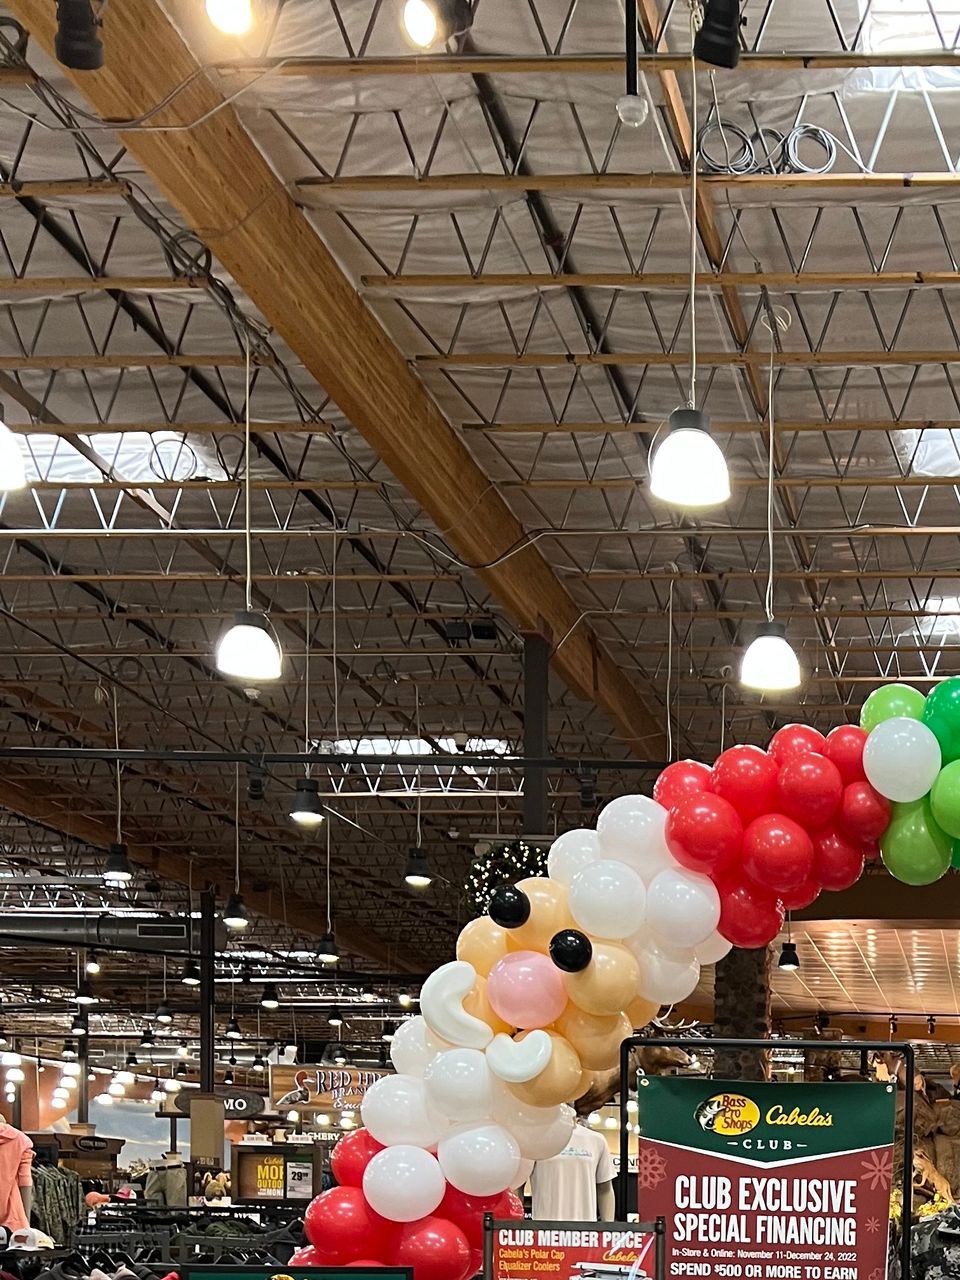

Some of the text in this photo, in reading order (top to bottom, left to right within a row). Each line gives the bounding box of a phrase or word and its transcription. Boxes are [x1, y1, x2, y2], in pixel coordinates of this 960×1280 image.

[722, 1095, 747, 1108] Bass
[722, 1107, 741, 1118] Pro
[765, 1105, 834, 1127] Cabela's
[721, 1117, 753, 1131] Shops
[742, 1139, 793, 1150] CLUB
[675, 1175, 858, 1214] CLUB EXCLUSIVE
[672, 1213, 857, 1246] SPECIAL FINANCING
[499, 1230, 599, 1248] CLUB MEMBER
[499, 1249, 566, 1261] Cabela's Polar Cap
[672, 1248, 857, 1262] In-Store & Online: November 11-December 24, 2022
[499, 1261, 561, 1272] Equalizer Coolers
[670, 1262, 858, 1280] SPEND $500 OR MORE TO EARN
